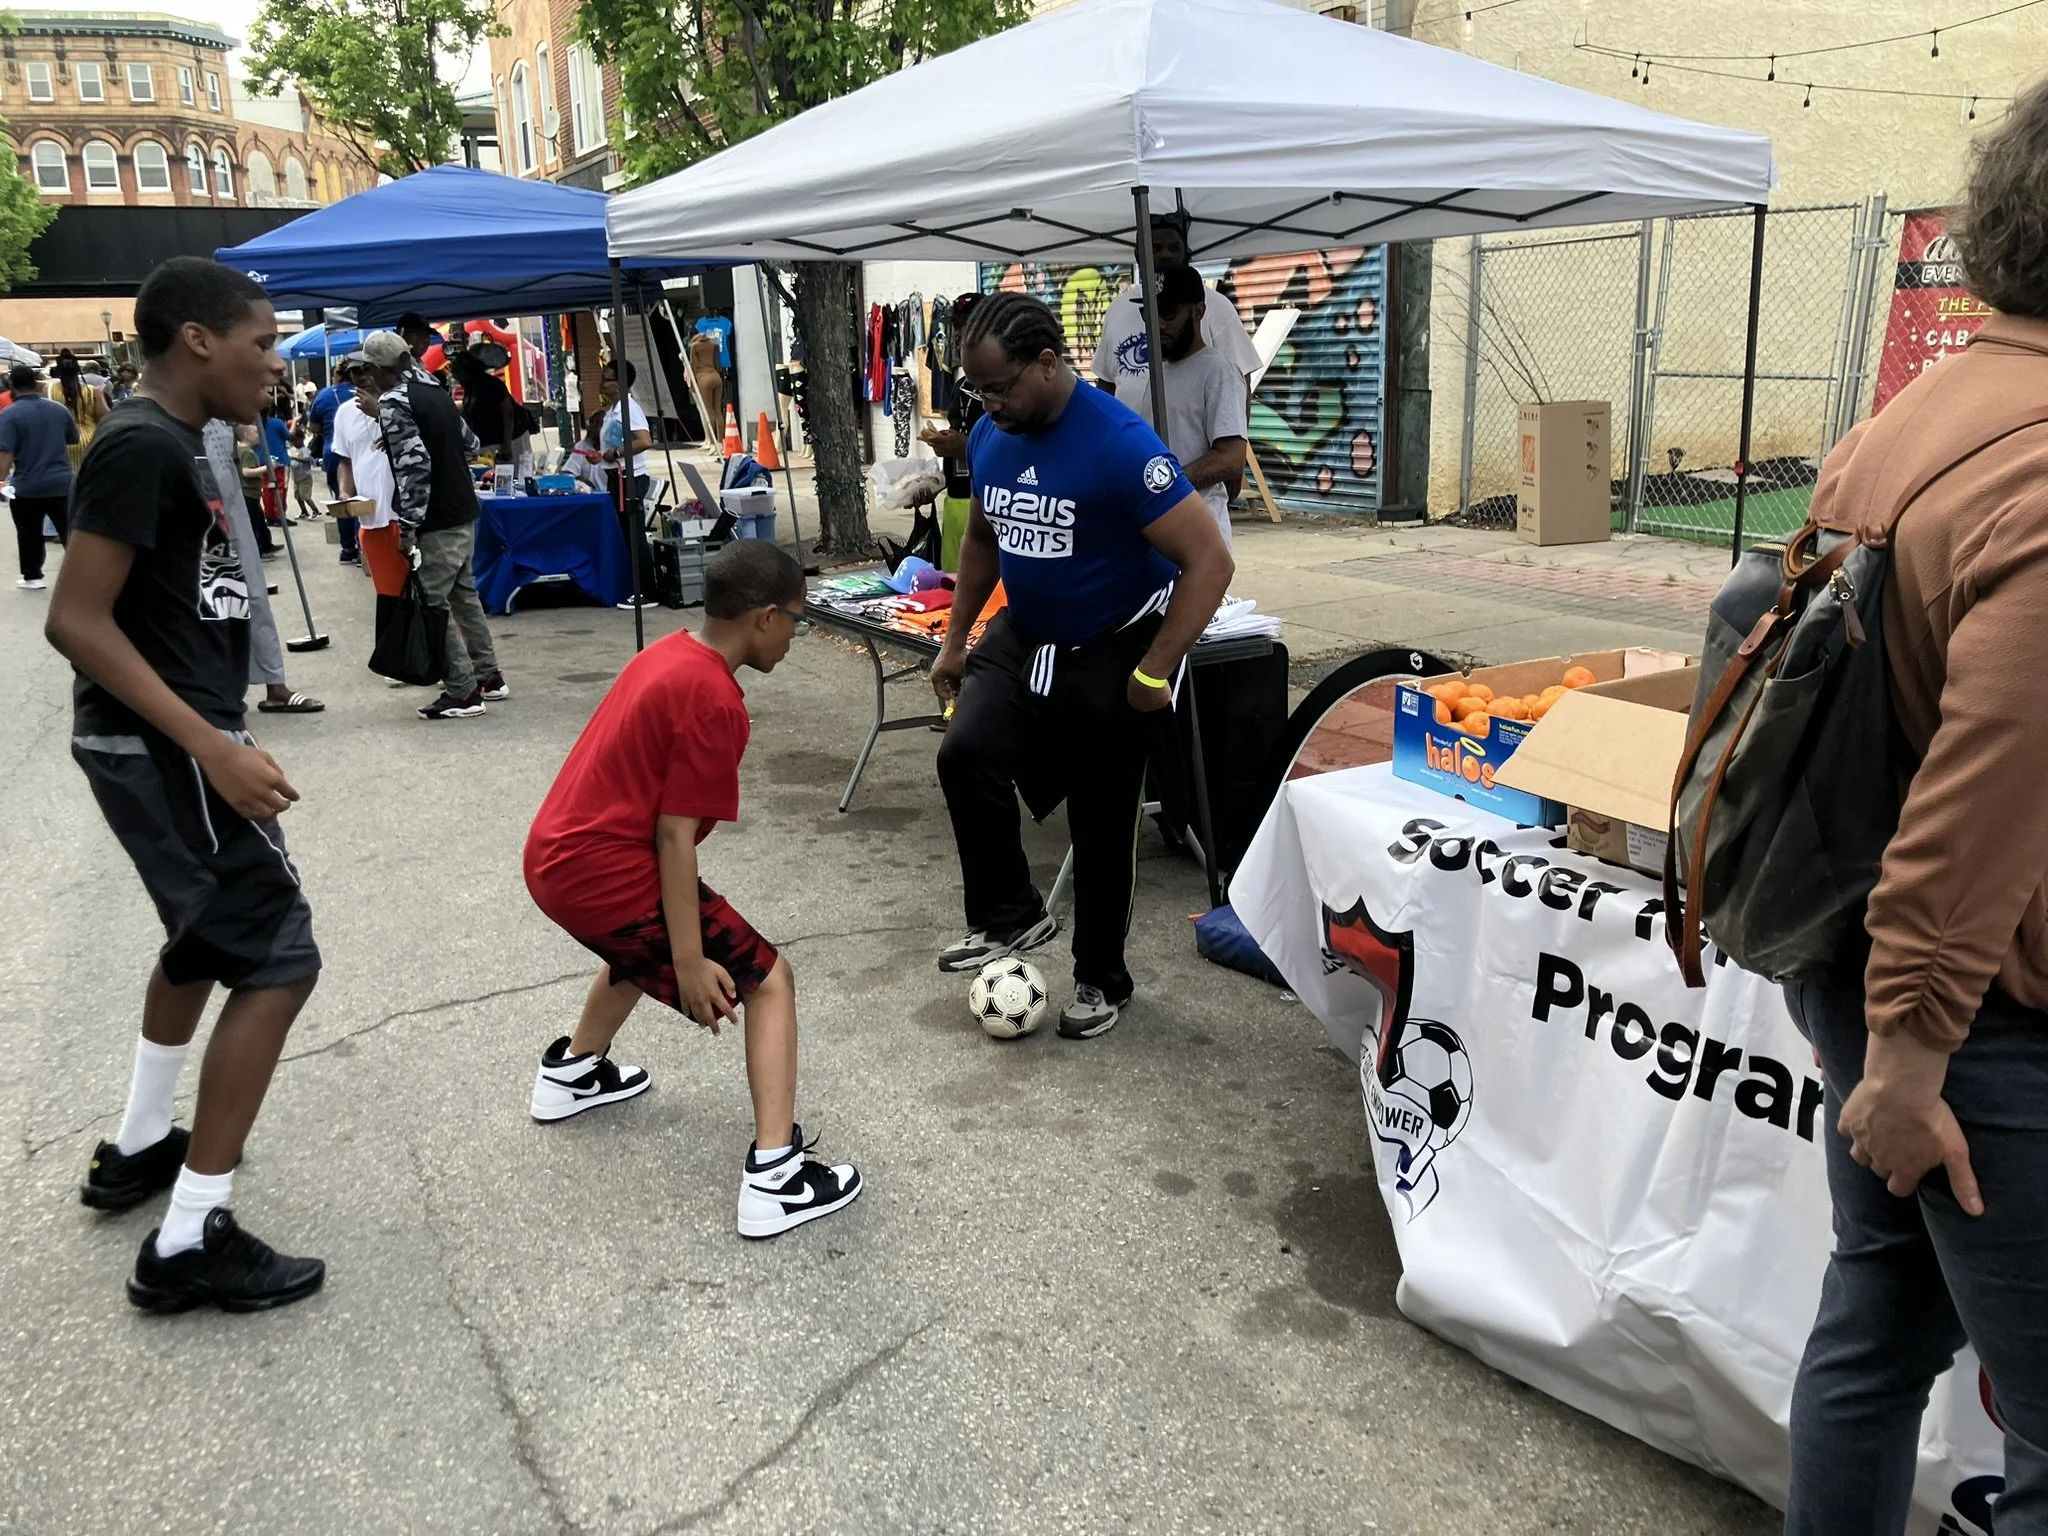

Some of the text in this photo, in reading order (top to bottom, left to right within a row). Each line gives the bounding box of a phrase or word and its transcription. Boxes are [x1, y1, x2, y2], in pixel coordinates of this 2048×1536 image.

[1939, 297, 1971, 312] THE
[1925, 329, 1969, 346] CAB
[1017, 476, 1038, 486] adidas
[1425, 731, 1496, 790] halos
[1387, 818, 1631, 921] Soccer
